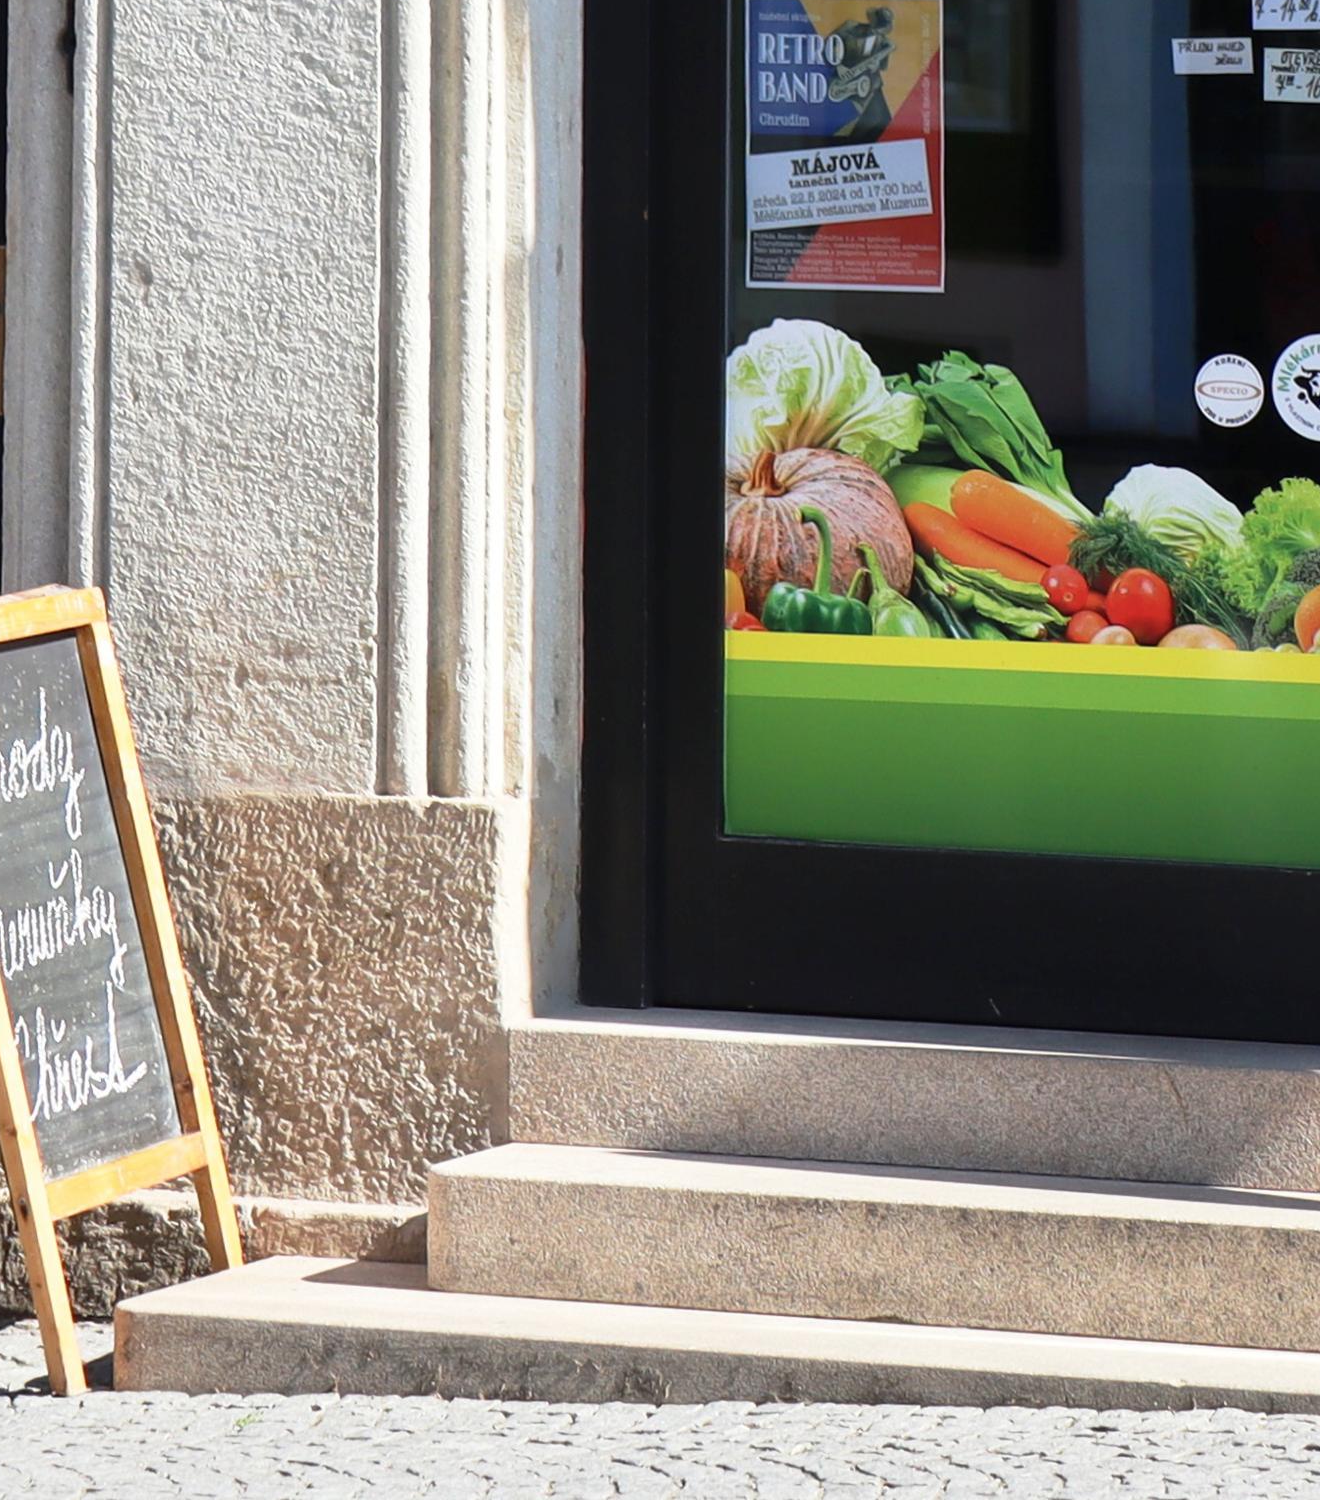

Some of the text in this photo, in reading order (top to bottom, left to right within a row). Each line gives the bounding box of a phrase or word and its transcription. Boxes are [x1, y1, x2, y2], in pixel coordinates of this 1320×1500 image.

[758, 33, 845, 66] RETRO
[759, 71, 827, 104] BAND
[759, 113, 810, 127] Chrudim
[790, 147, 880, 176] MÁJOVÁ
[789, 171, 886, 189] taneční zábava
[850, 186, 864, 199] od
[867, 183, 899, 197] 17:00
[816, 203, 876, 218] restaurace
[879, 196, 929, 211] Muzeum
